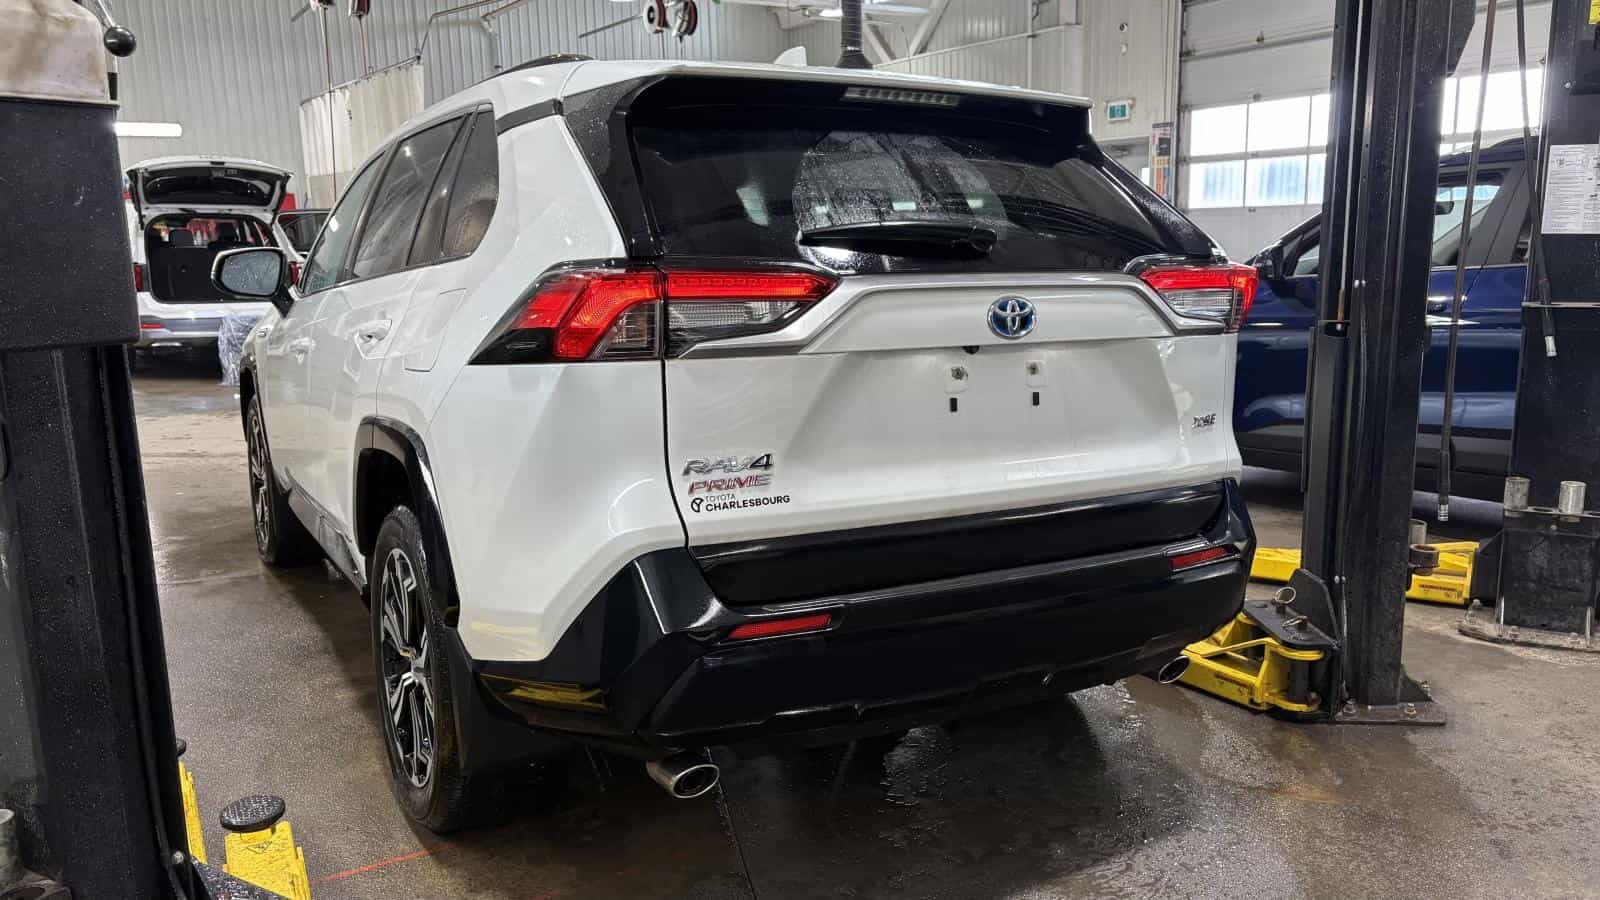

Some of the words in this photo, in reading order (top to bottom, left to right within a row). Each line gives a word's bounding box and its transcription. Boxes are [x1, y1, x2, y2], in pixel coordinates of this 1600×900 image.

[682, 453, 774, 476] RAV4
[688, 474, 774, 495] PRIME
[705, 493, 736, 503] TOYOTA
[705, 495, 791, 512] CHARLESBOURG
